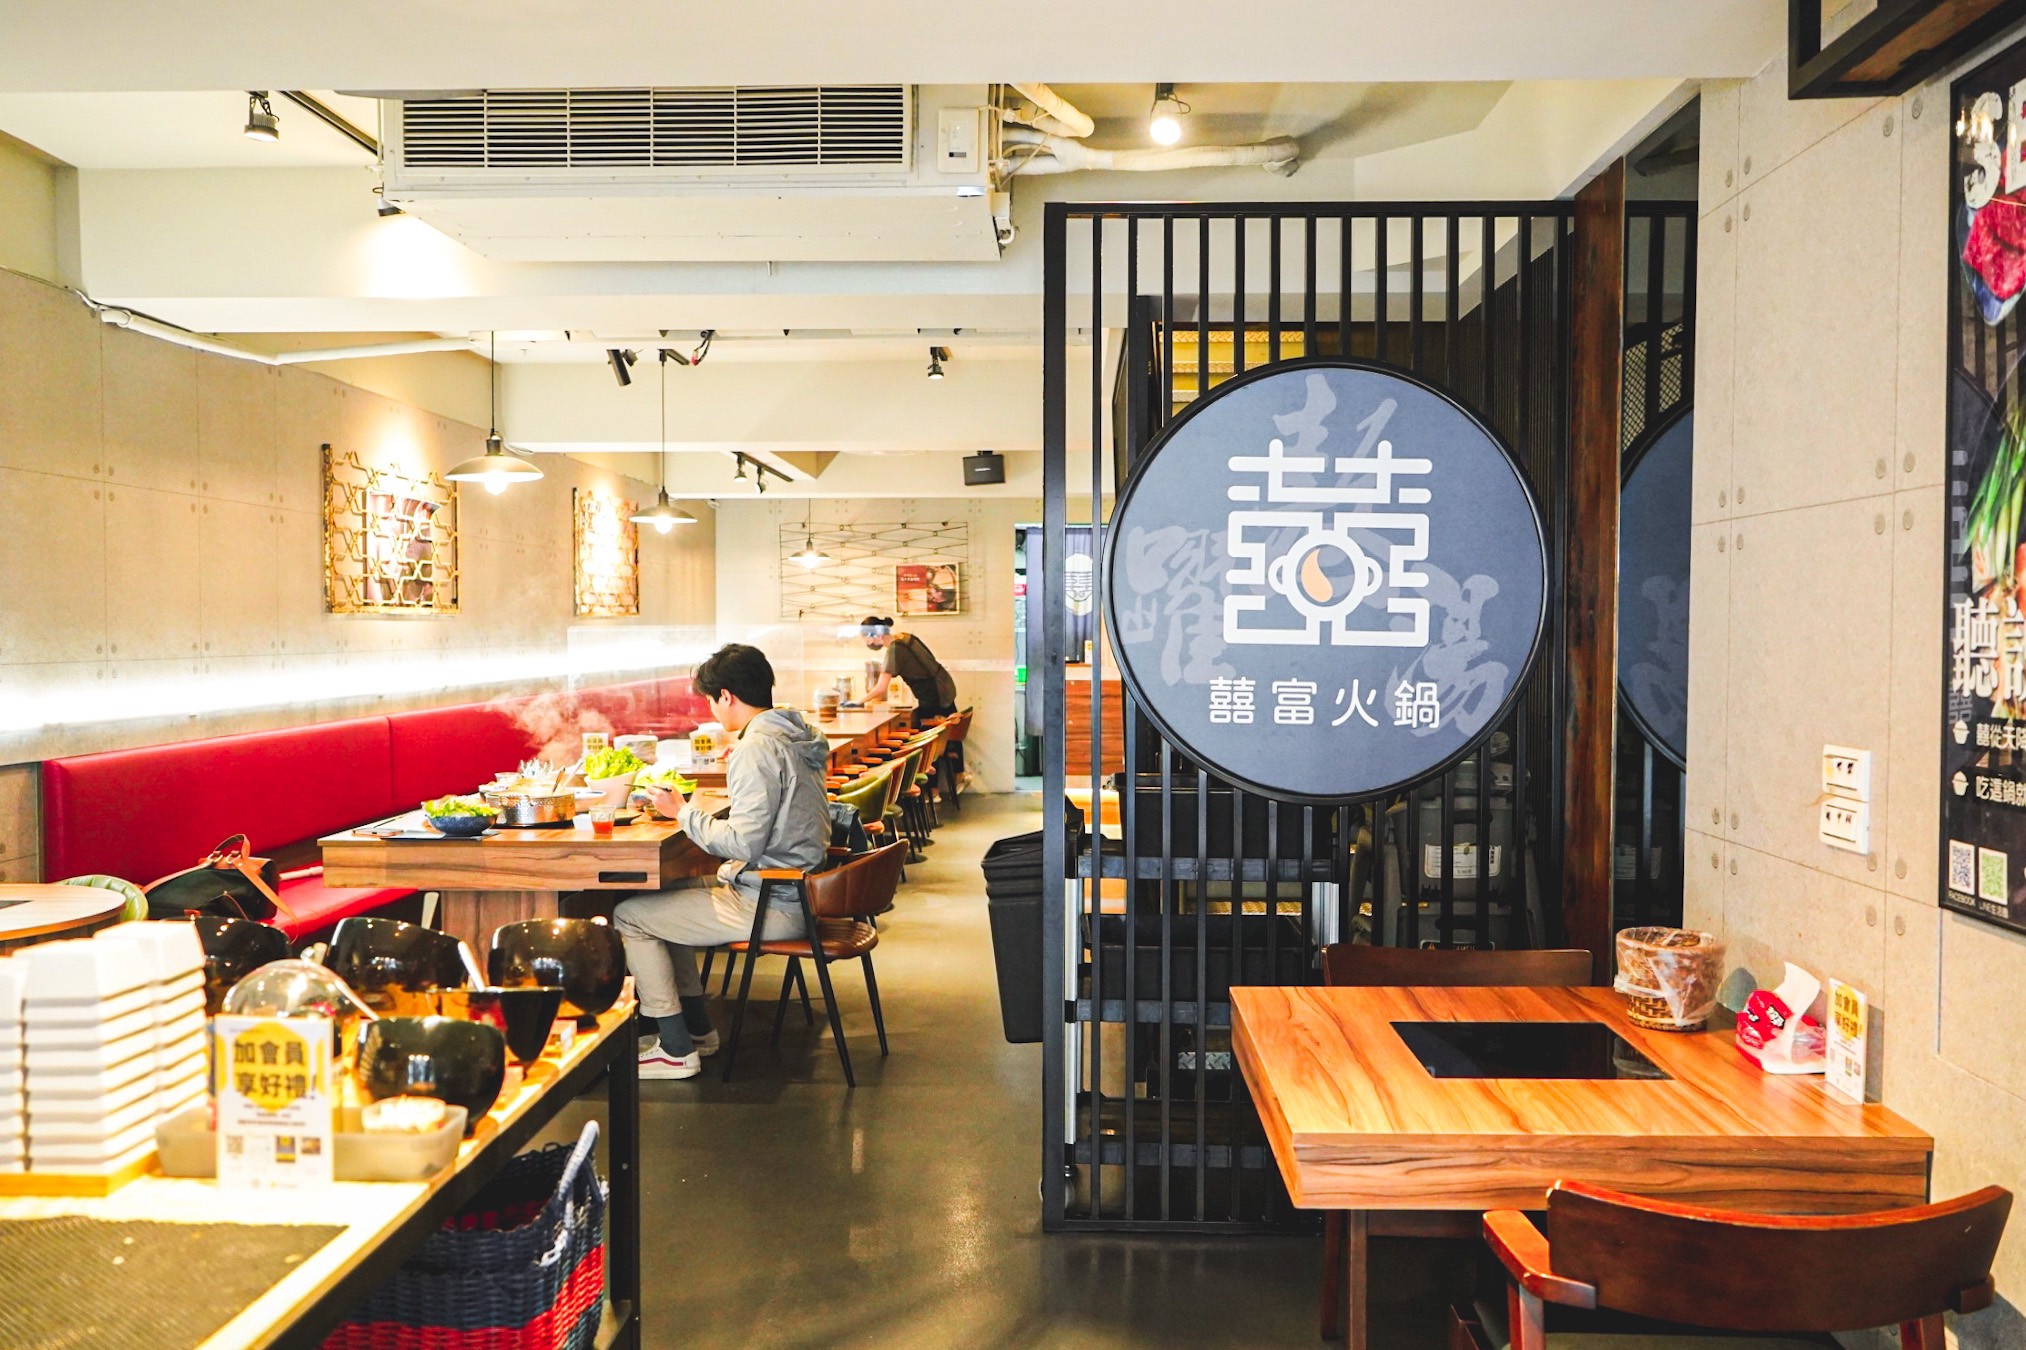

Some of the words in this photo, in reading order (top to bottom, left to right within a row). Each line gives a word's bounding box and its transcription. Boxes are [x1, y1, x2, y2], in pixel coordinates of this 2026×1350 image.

[1208, 676, 1440, 729] 囍富火鍋
[233, 1040, 305, 1066] 加會員
